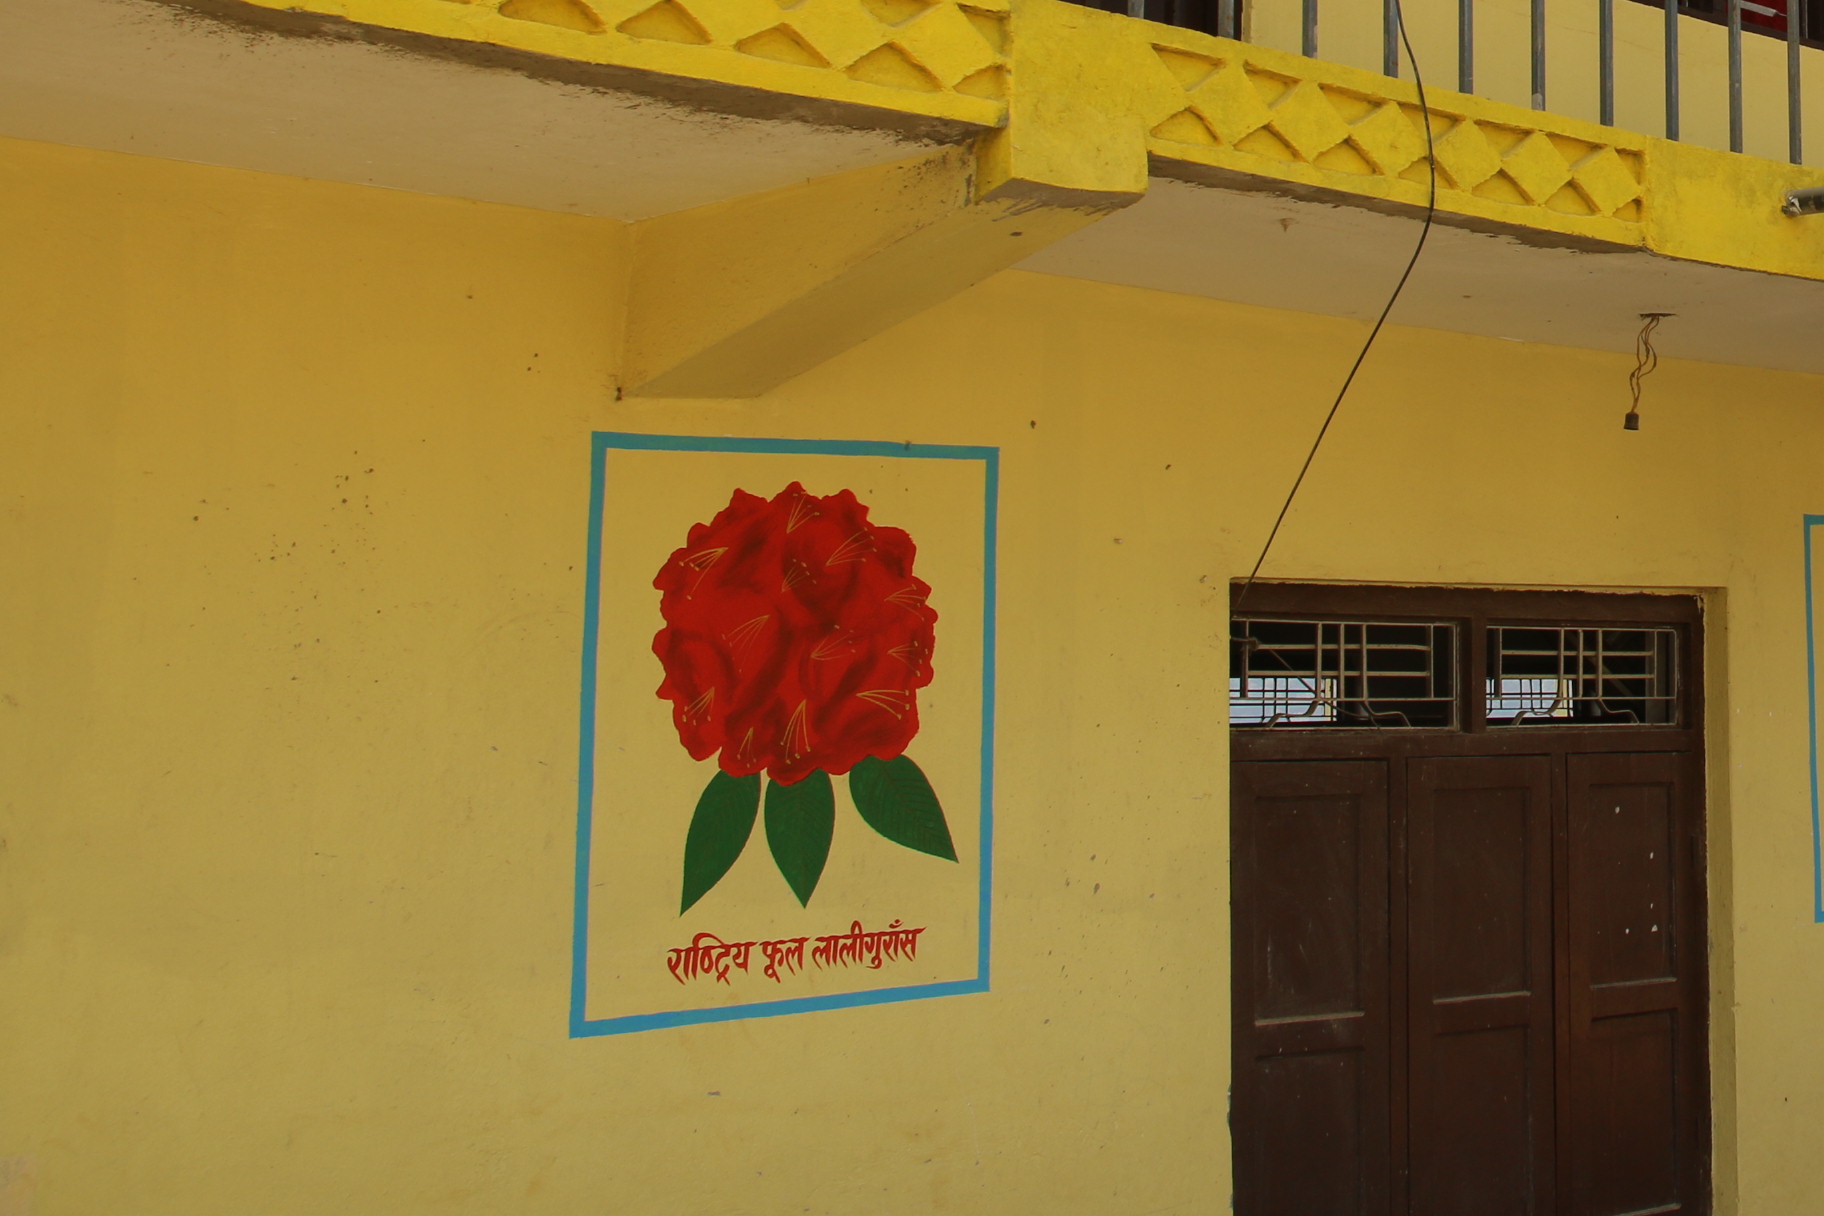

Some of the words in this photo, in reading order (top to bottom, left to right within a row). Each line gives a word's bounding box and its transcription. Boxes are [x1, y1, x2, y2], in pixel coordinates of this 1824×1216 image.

[666, 932, 759, 985] राष्ट्रिय
[759, 936, 810, 983] फूल
[811, 919, 928, 972] लालीगुराँस
